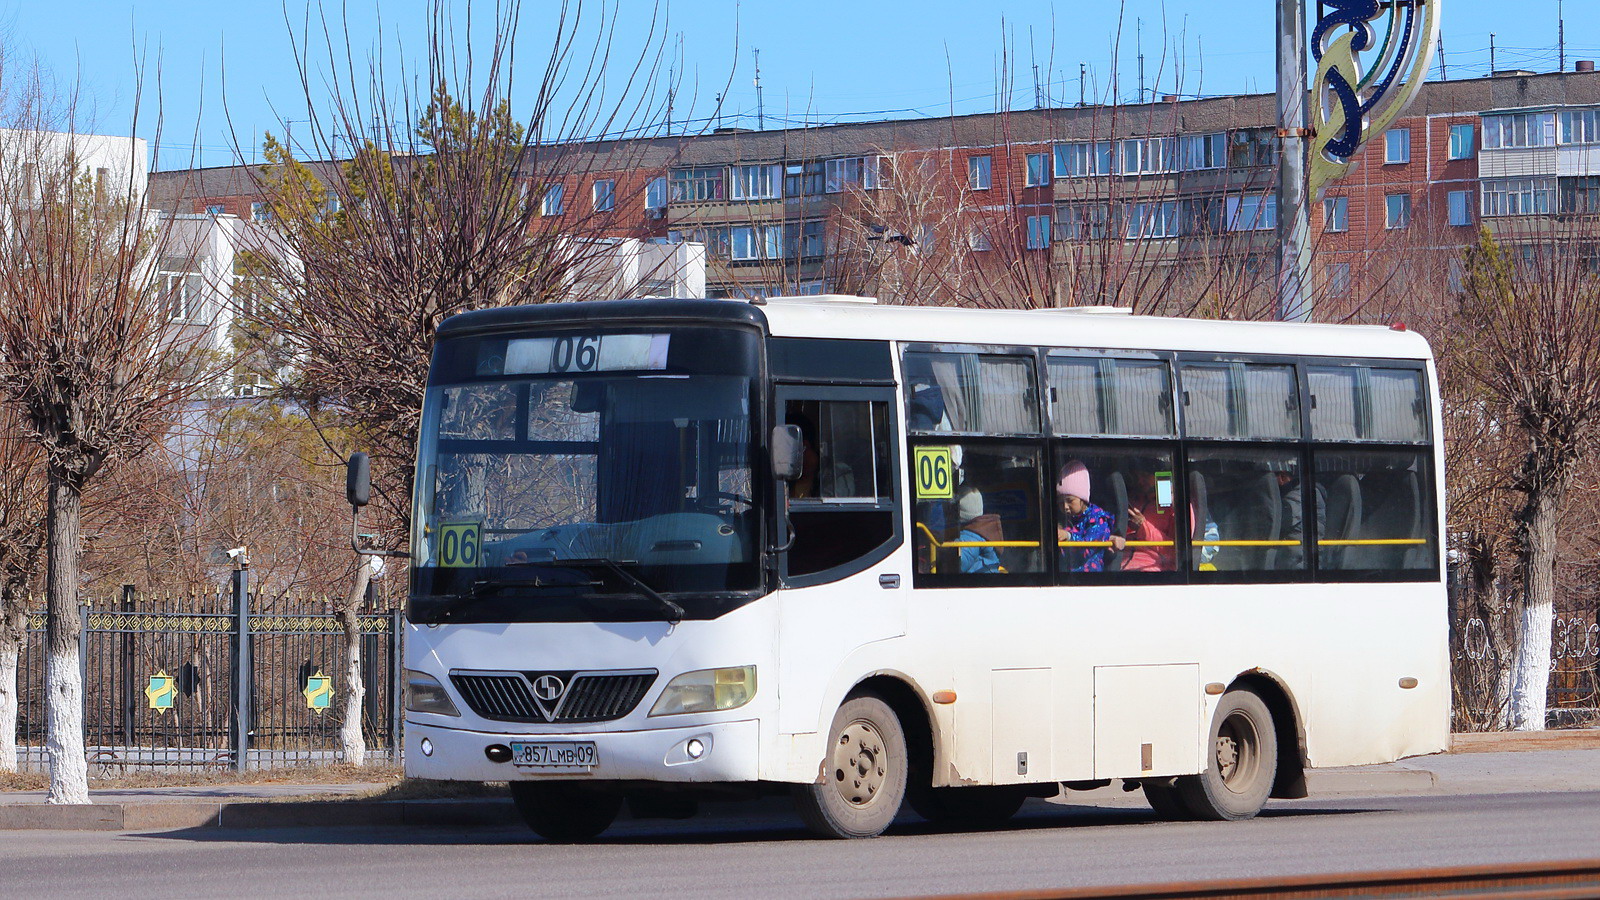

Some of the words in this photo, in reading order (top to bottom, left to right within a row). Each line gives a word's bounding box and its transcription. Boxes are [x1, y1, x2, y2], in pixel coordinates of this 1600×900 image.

[552, 335, 598, 373] 06
[920, 455, 947, 490] 06
[443, 529, 476, 565] 06
